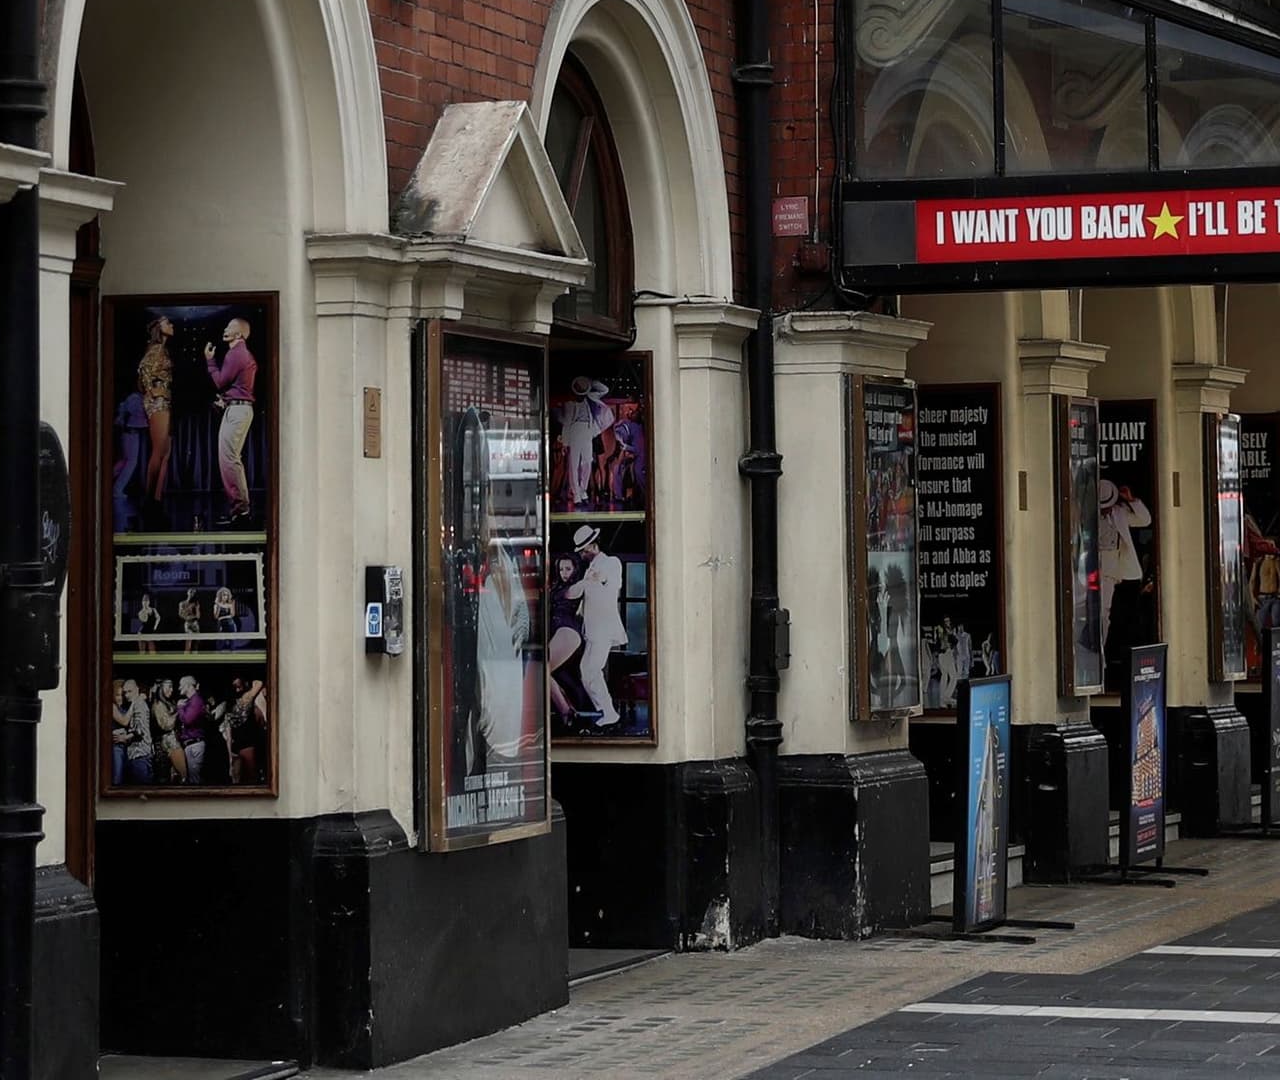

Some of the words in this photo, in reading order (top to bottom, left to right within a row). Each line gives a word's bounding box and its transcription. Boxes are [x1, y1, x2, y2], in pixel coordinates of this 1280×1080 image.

[935, 212, 946, 244] I
[951, 209, 1019, 244] WANT
[1027, 207, 1074, 243] YOU
[1080, 203, 1147, 241] BACK
[1187, 201, 1229, 238] I'LL
[1236, 199, 1268, 237] BE
[920, 408, 948, 424] sheer
[950, 405, 990, 426] majesty
[921, 431, 937, 448] the
[938, 429, 977, 448] musical
[966, 452, 986, 470] will
[1111, 443, 1144, 463] OUT'
[952, 476, 972, 494] that
[927, 501, 984, 520] MJ-homage
[935, 526, 976, 544] surpass
[932, 548, 950, 565] and
[952, 547, 977, 565] Abba
[979, 549, 992, 564] as
[930, 571, 947, 589] End
[948, 570, 989, 591] staples'
